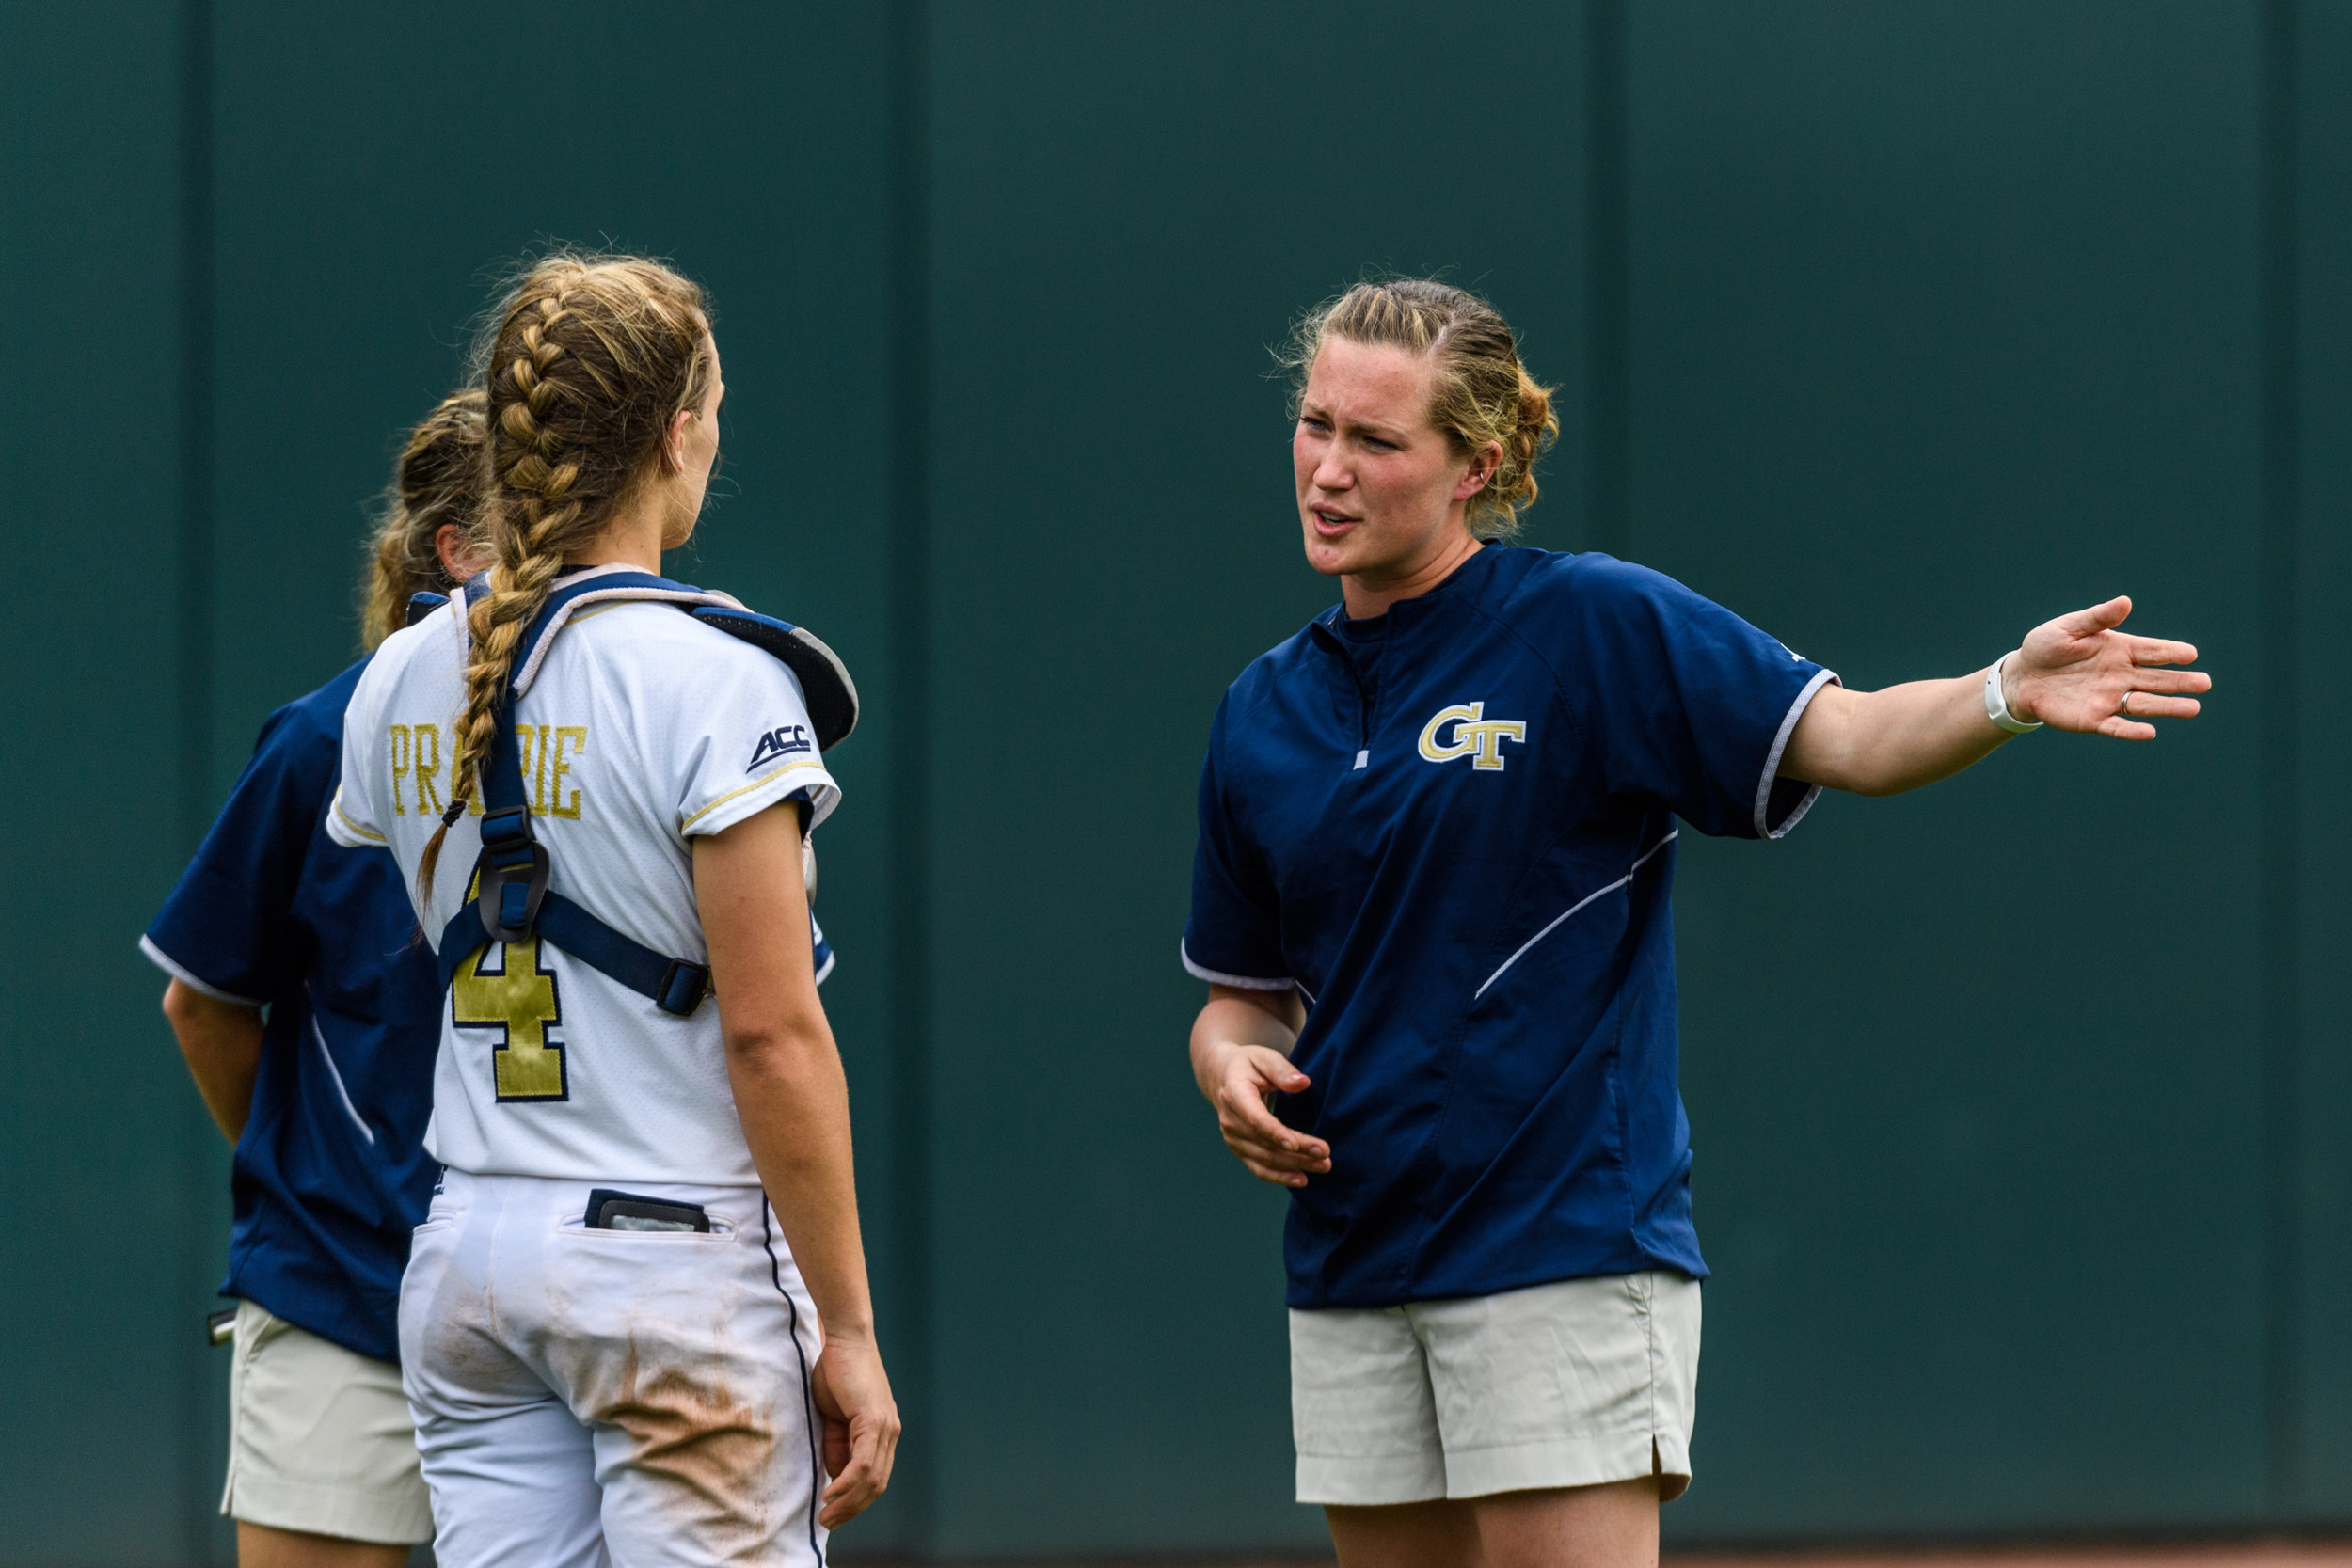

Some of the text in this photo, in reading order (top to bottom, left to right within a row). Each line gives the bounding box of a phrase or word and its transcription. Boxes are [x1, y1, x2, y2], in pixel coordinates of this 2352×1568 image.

[390, 723, 587, 820] PRAIE
[749, 724, 811, 765] ACC
[1418, 701, 1526, 771] GT
[452, 848, 569, 1102] 4
